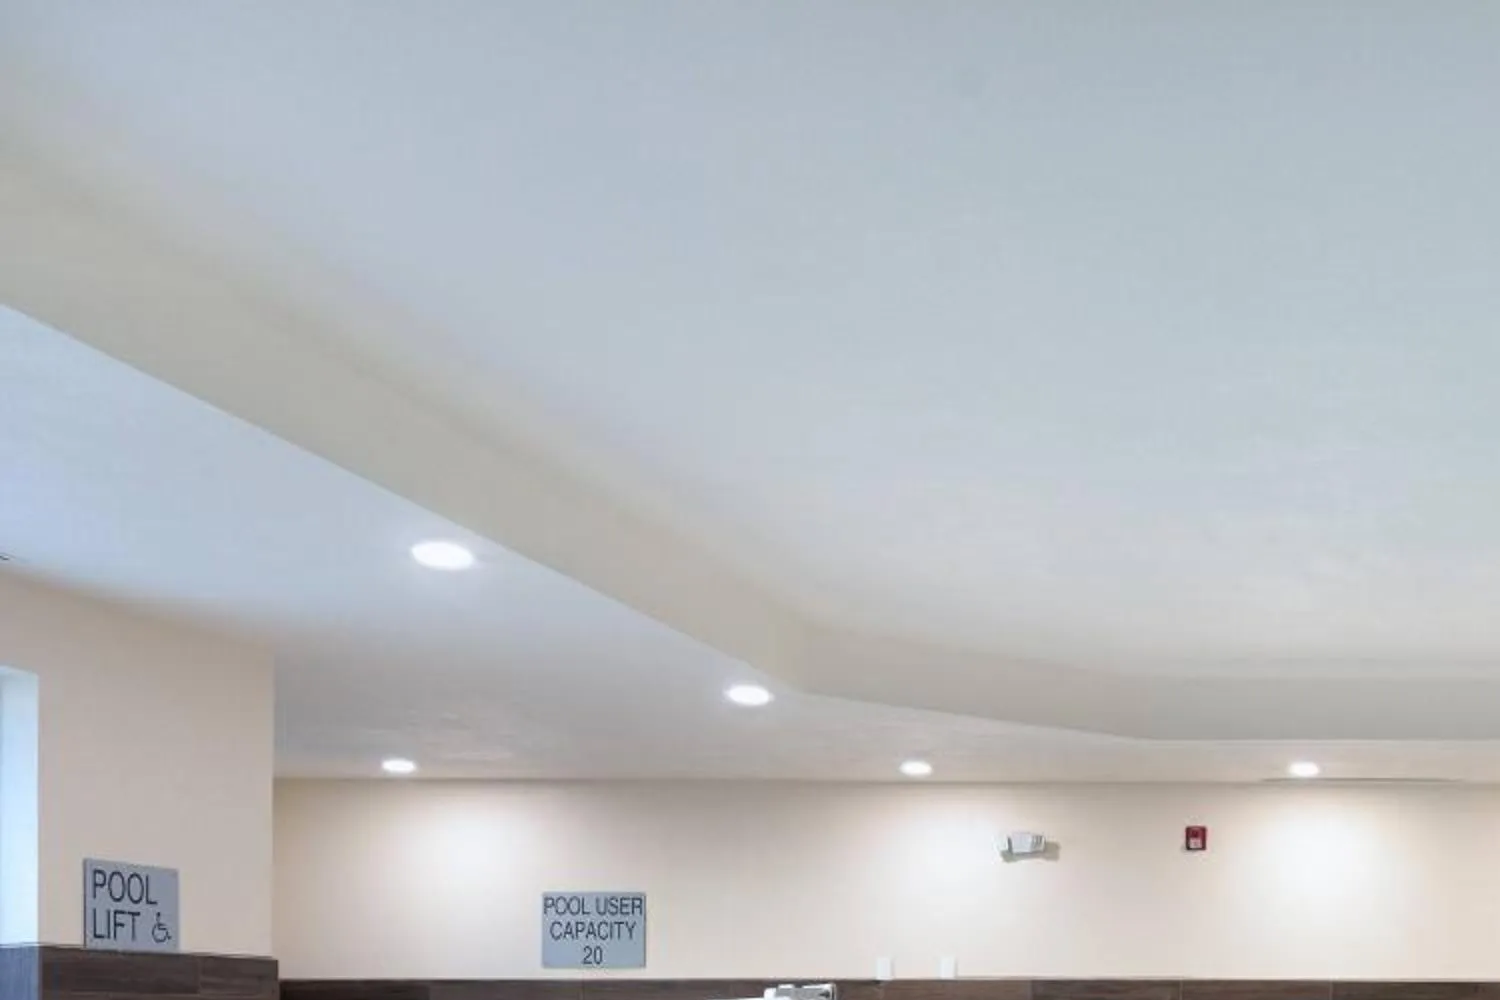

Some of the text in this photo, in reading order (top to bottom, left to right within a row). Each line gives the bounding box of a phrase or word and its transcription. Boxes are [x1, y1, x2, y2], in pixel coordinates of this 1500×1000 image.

[92, 869, 158, 905] POOL
[543, 895, 644, 916] POOL USER
[92, 907, 141, 942] LIFT
[549, 921, 637, 941] CAPACITY
[582, 945, 603, 965] 20
